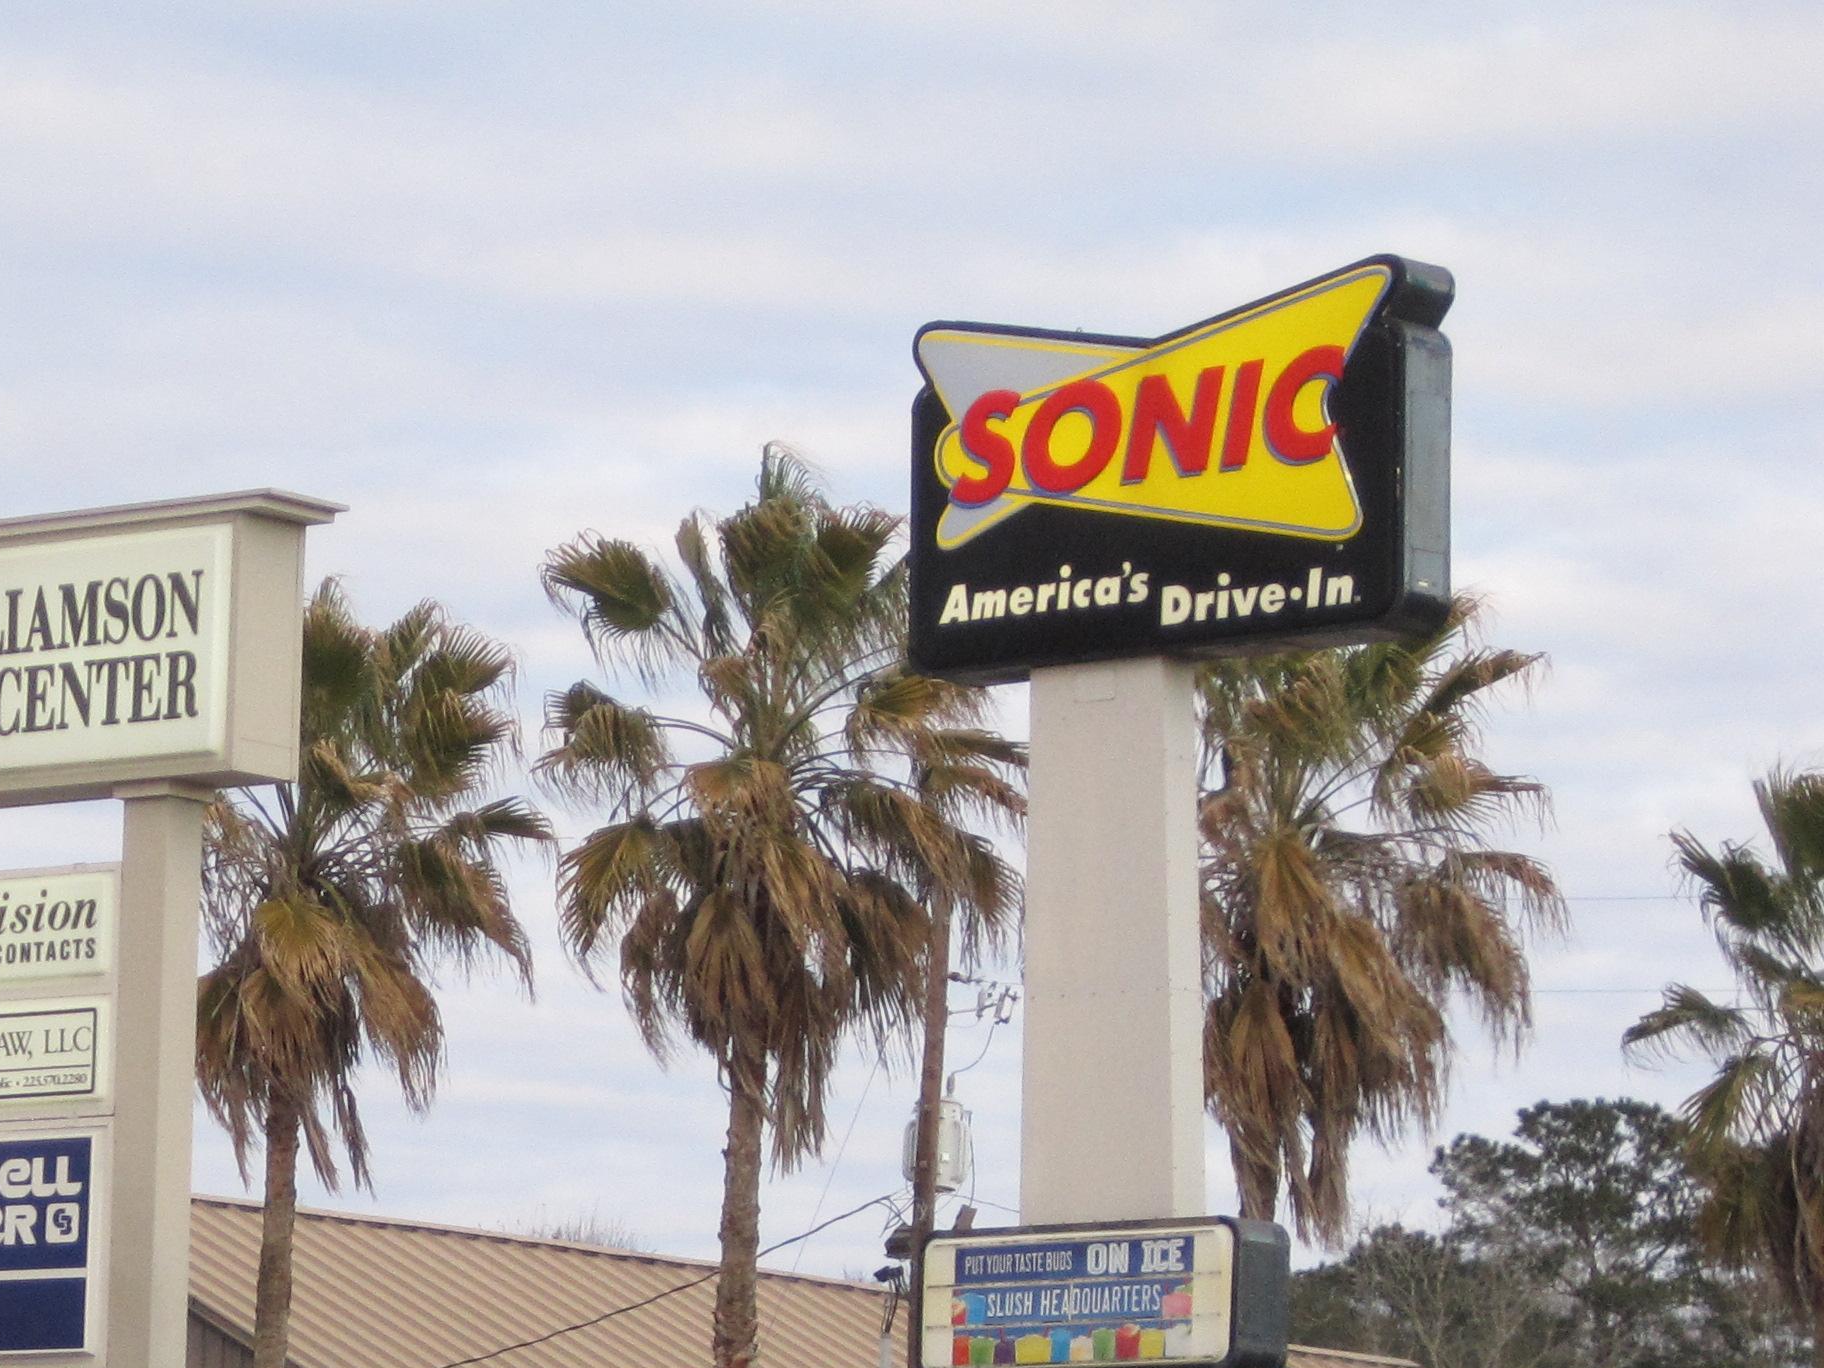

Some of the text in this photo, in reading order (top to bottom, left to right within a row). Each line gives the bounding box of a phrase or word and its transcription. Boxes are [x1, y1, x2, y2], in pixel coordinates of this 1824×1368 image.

[948, 345, 1346, 510] SONIC
[939, 562, 1150, 626] America's
[43, 1026, 92, 1055] LLC
[964, 1239, 1185, 1276] PUT YOUR TASTE BUDS ON ICE
[986, 1283, 1161, 1318] SLUSH HEADQUARTERS
